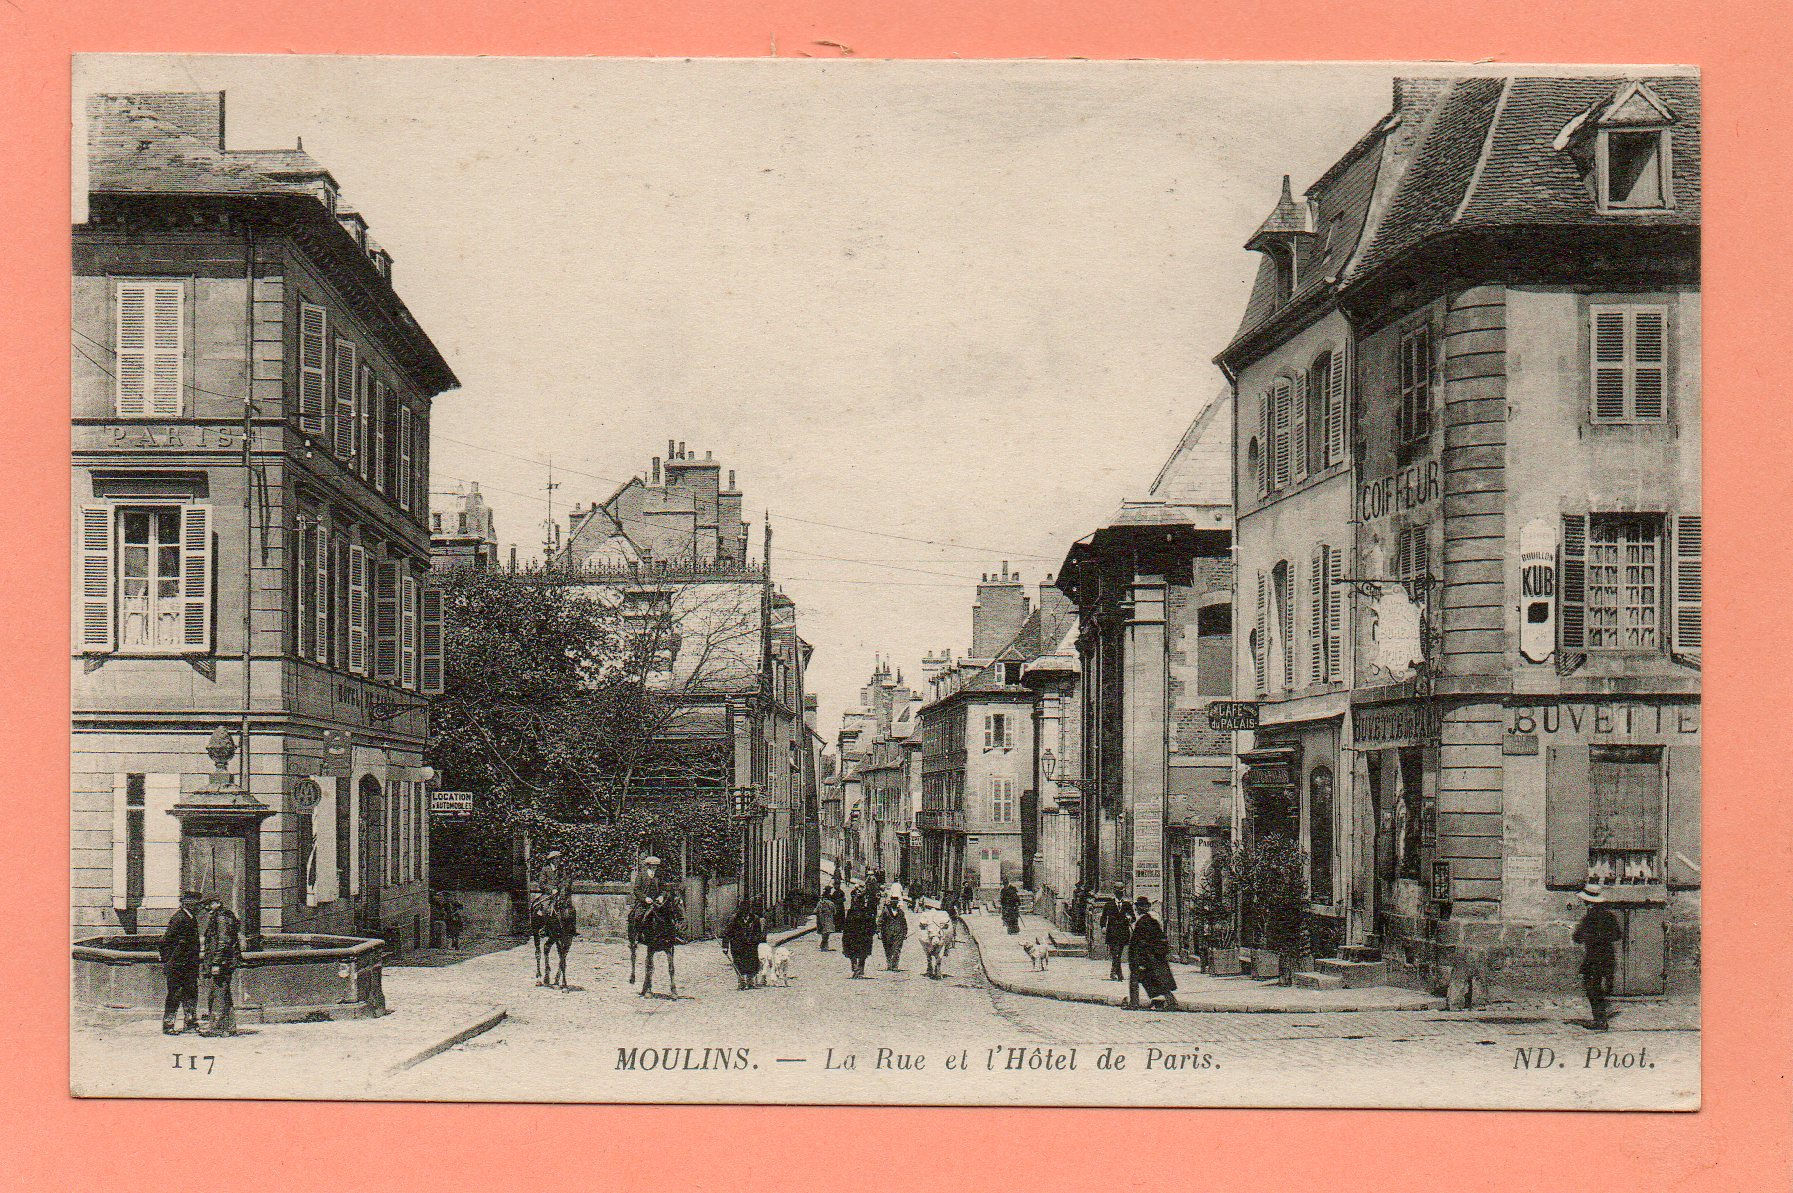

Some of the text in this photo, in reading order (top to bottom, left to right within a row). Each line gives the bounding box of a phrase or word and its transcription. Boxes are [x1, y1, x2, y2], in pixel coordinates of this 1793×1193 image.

[106, 426, 233, 448] PARIS
[1362, 460, 1439, 521] COIFFEUR
[1522, 565, 1553, 597] KUB
[1211, 718, 1255, 729] du PALAIS
[1508, 704, 1698, 734] BUVETTE
